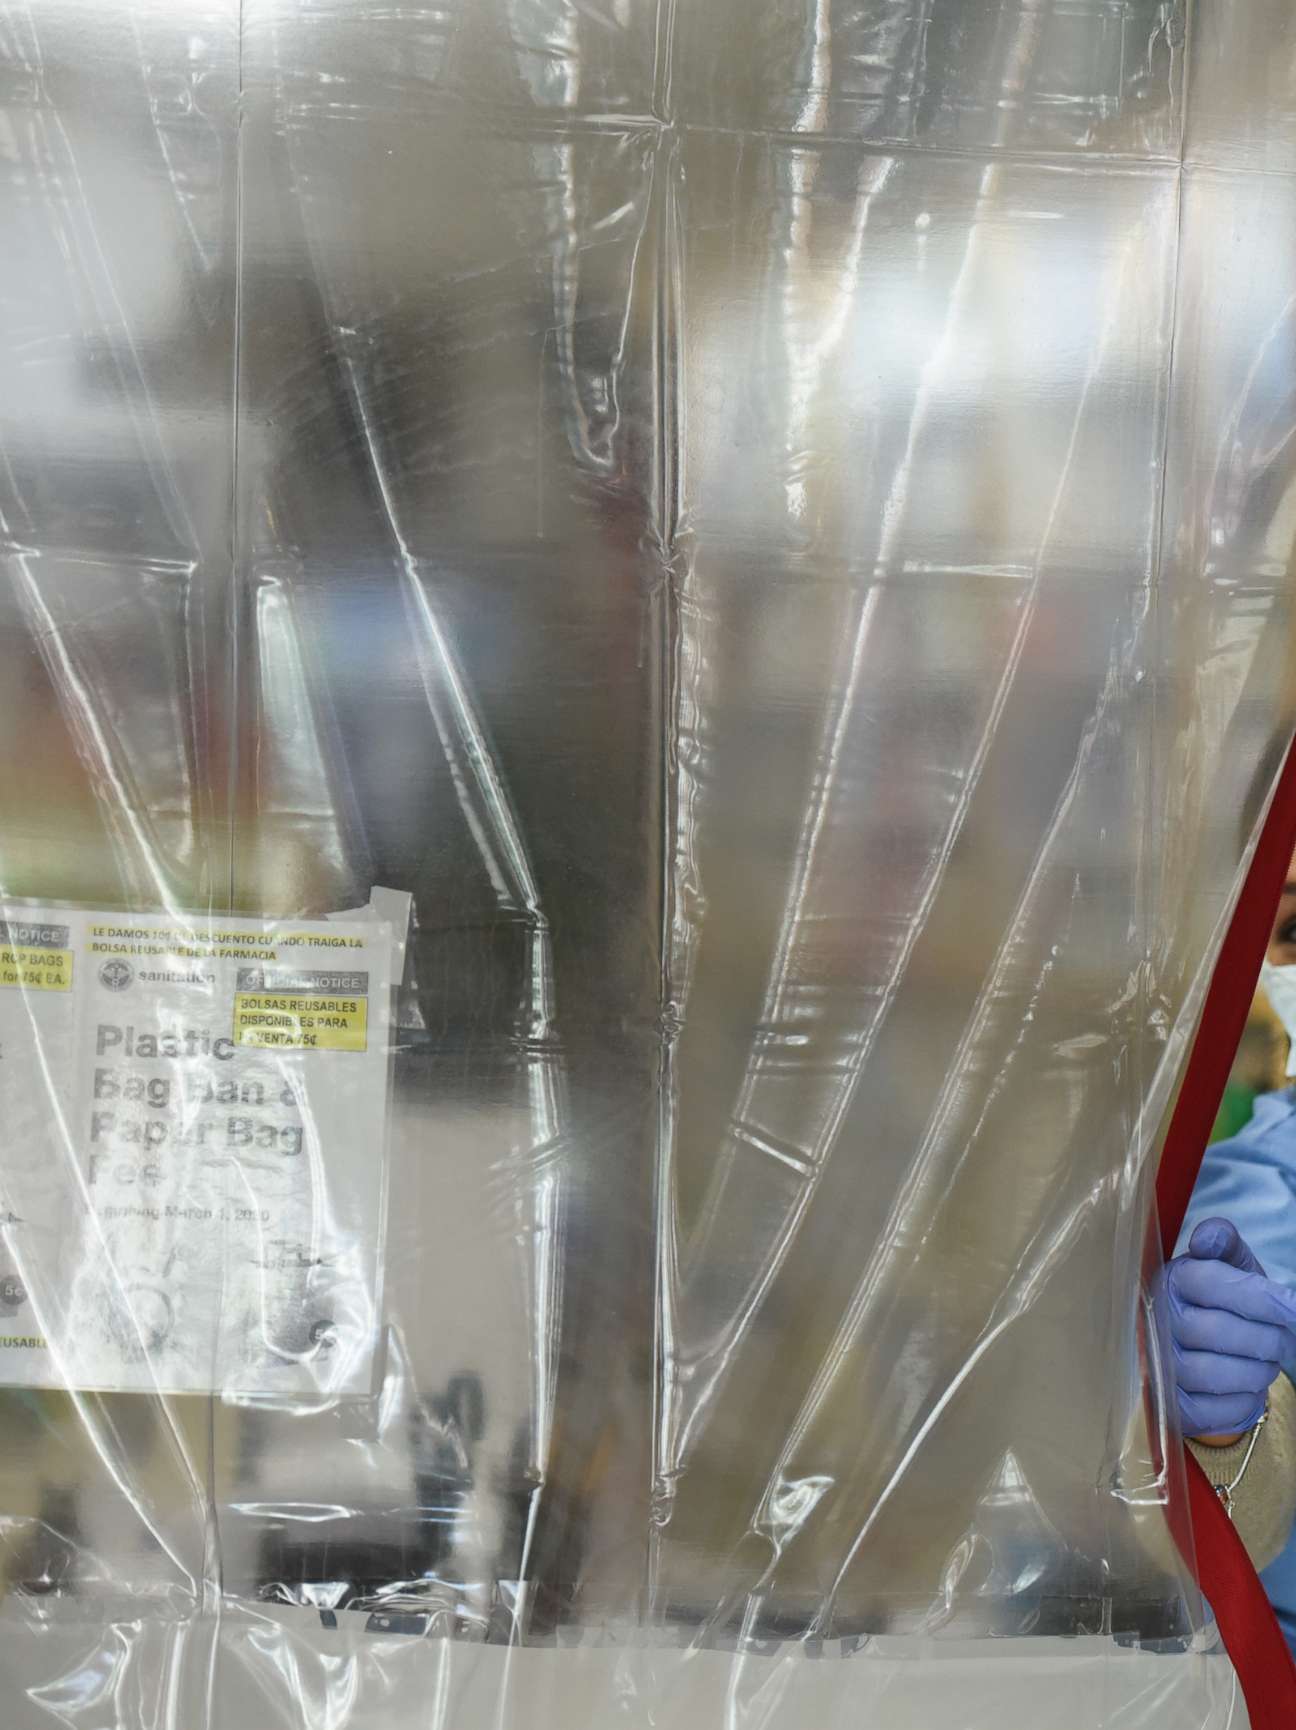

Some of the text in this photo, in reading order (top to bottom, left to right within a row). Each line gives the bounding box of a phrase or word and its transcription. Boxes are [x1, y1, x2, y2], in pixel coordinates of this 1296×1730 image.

[93, 927, 104, 937] LE
[107, 928, 149, 939] DAMOS
[307, 937, 346, 948] TRAIGA
[350, 938, 363, 948] LA
[30, 953, 64, 967] BAGS
[92, 943, 128, 953] BOLSA
[220, 949, 277, 960] FARMACIA
[241, 999, 357, 1013] BOLSAS REUSABLES
[240, 1014, 349, 1029] DISPONIBES PARA
[95, 1023, 236, 1061] Plastic
[94, 1067, 171, 1109] Bag
[225, 1116, 304, 1157] Bag
